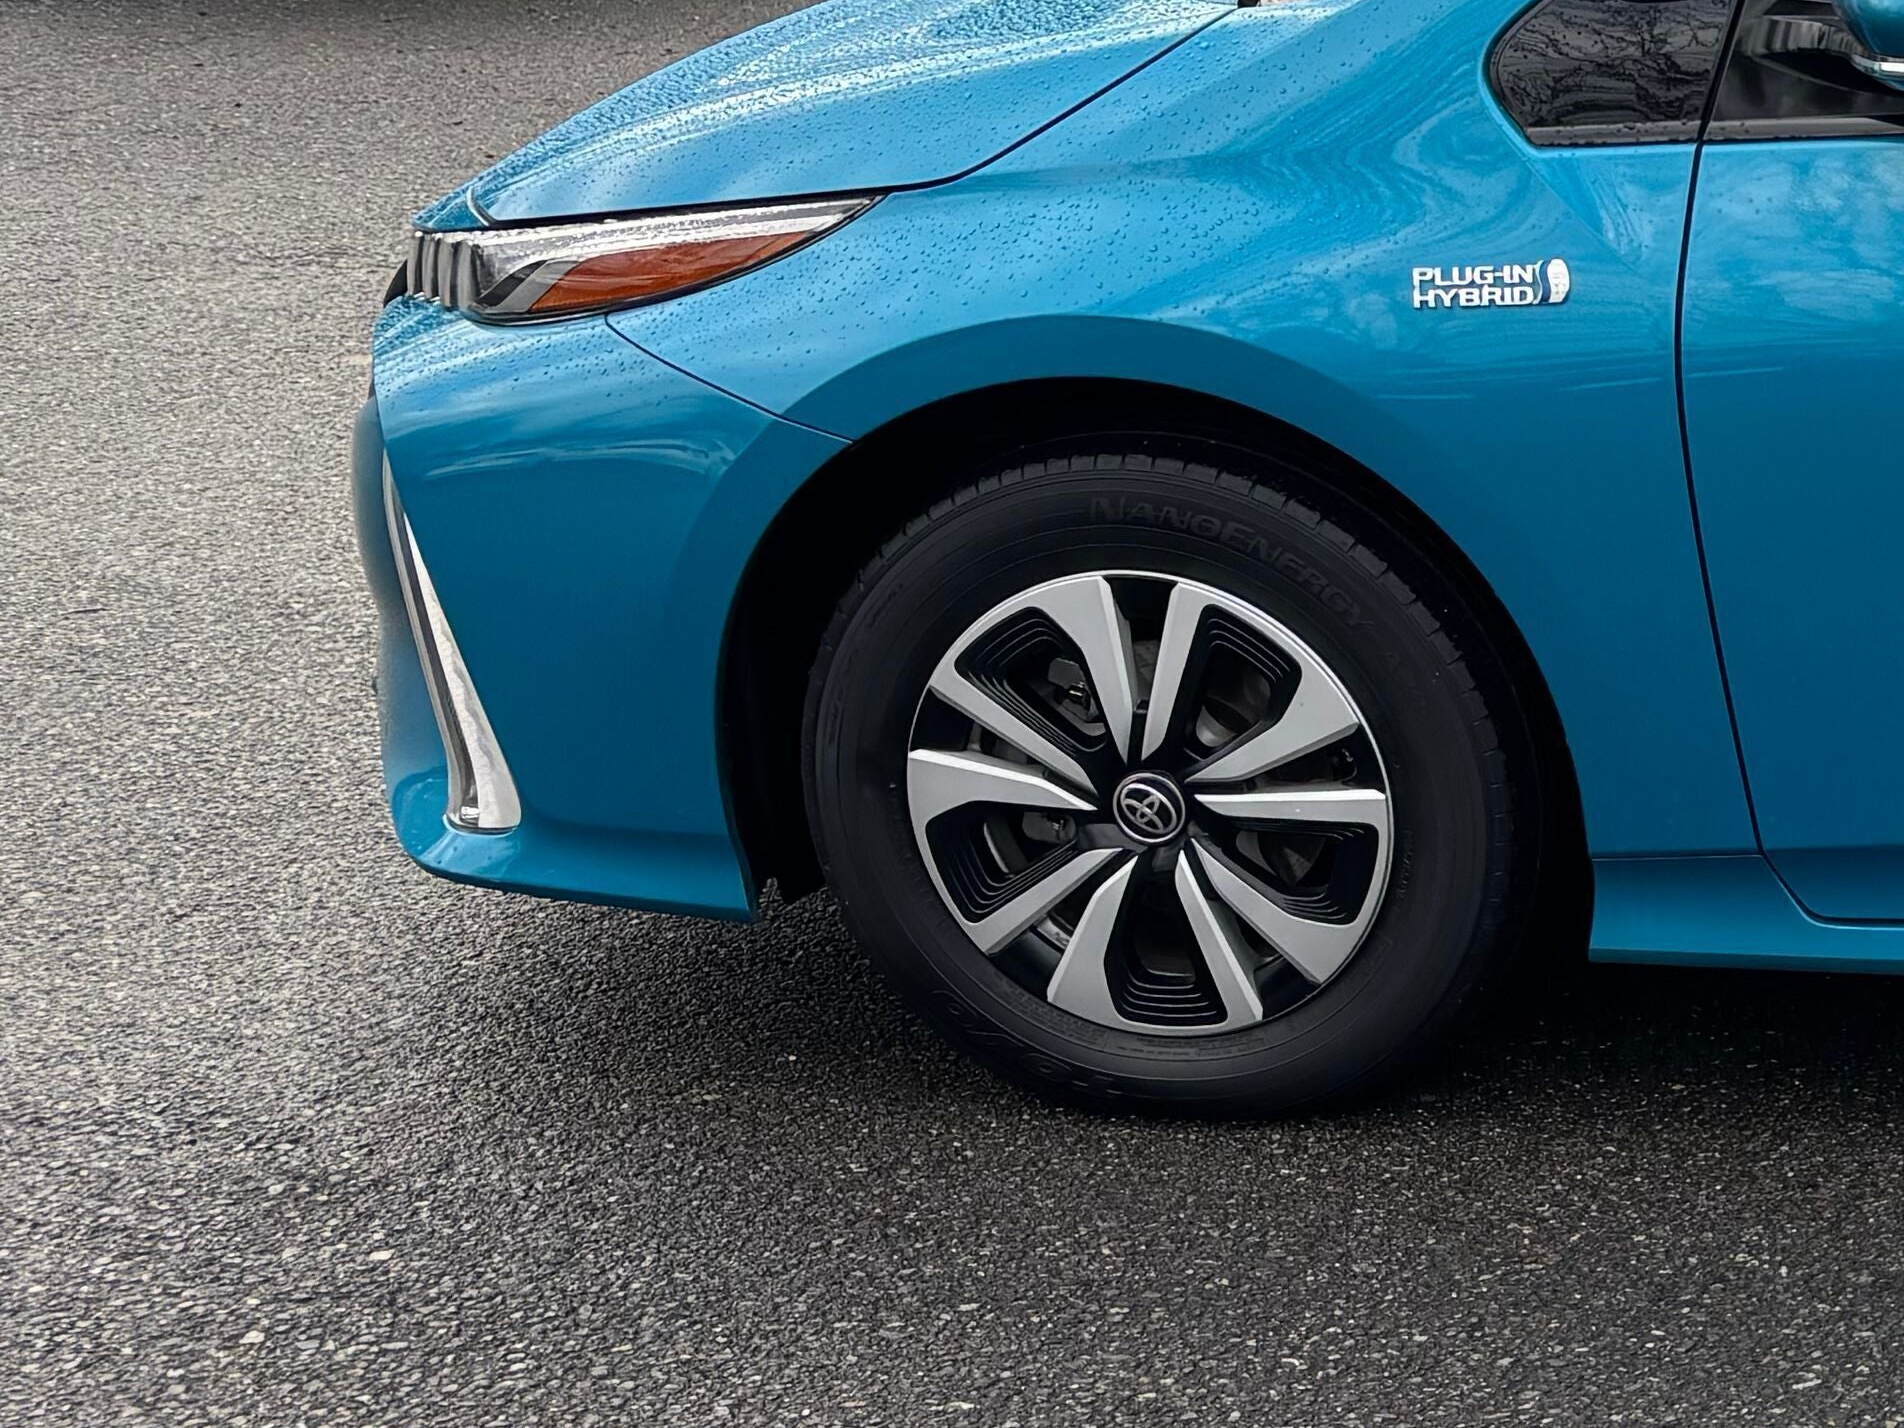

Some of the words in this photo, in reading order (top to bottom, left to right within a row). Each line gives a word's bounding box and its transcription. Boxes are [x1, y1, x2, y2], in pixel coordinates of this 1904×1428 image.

[1412, 264, 1537, 287] PLUG-IN
[1412, 285, 1534, 309] HYBRID
[1090, 496, 1375, 632] NANOENERGY
